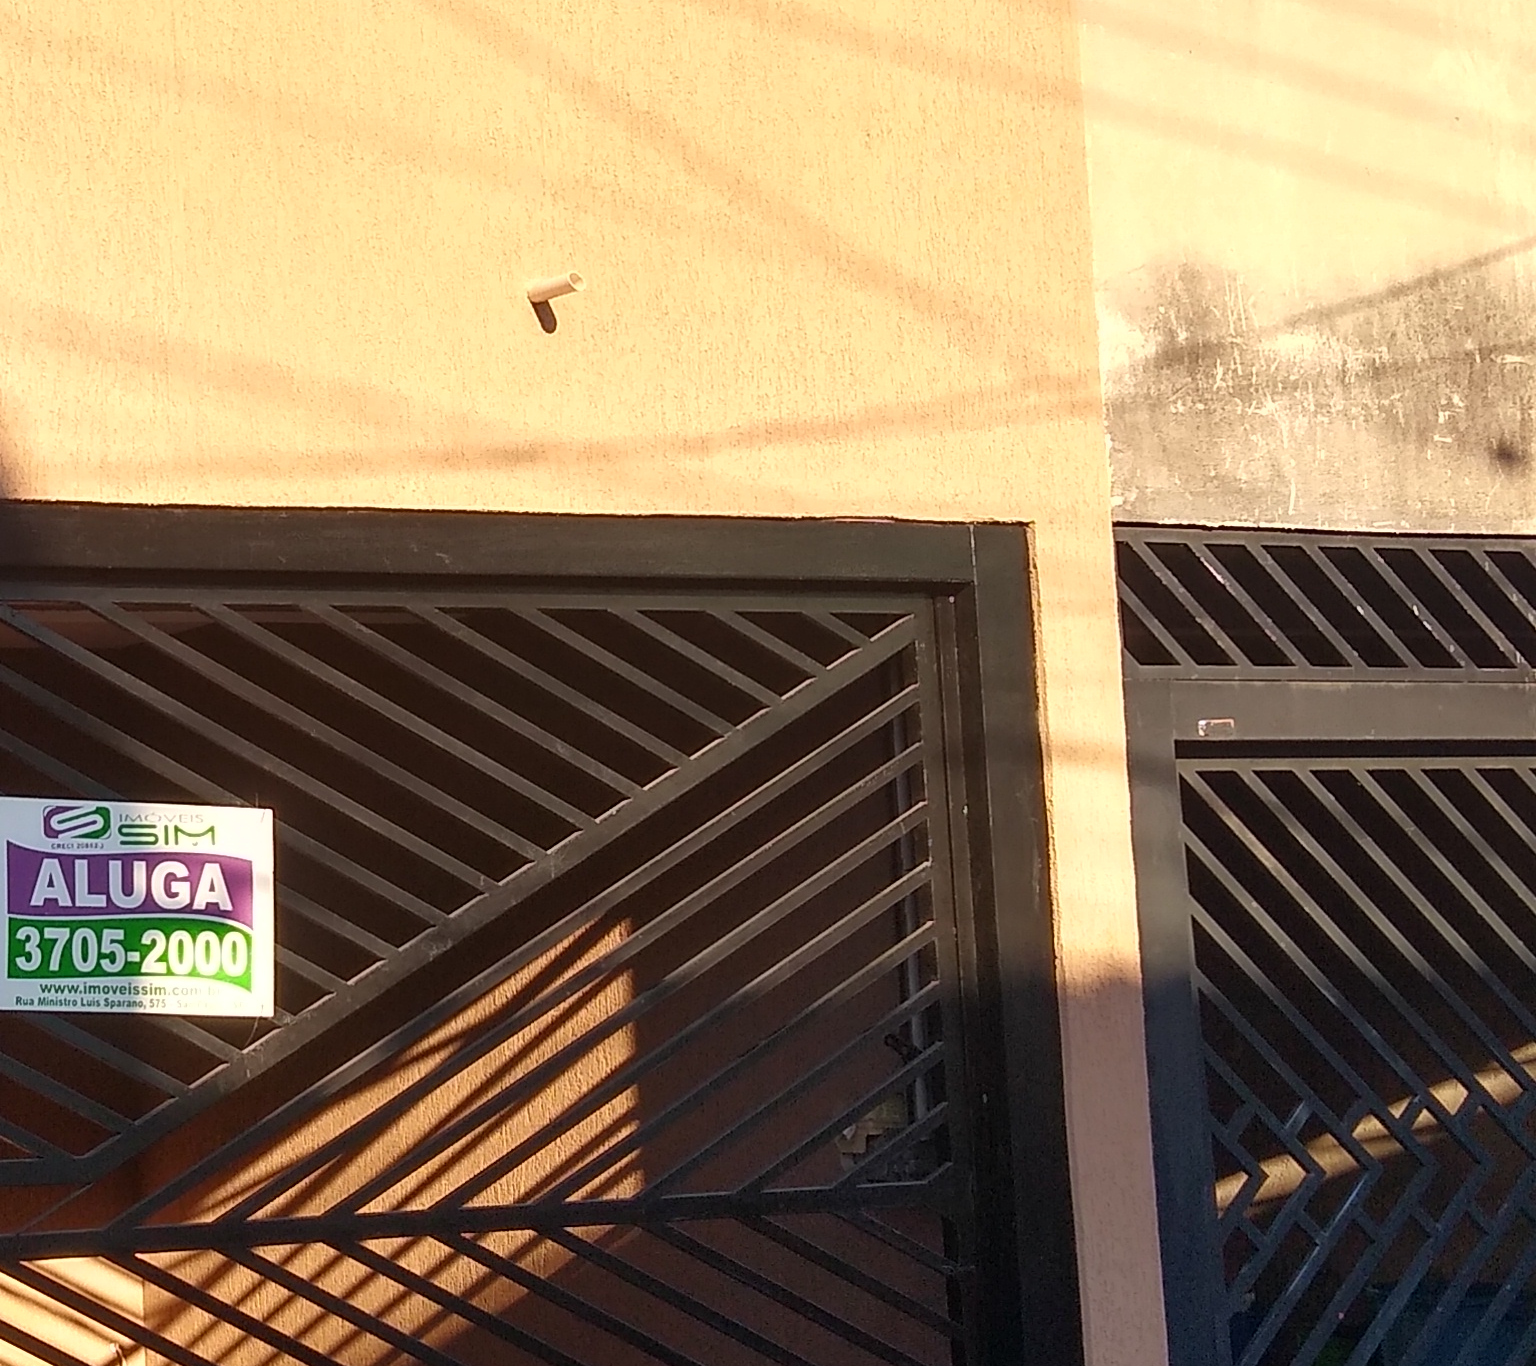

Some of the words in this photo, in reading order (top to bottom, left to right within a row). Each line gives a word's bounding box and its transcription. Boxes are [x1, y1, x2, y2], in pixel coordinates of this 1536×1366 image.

[119, 812, 204, 824] IMÓVEIS
[118, 824, 216, 846] SIM
[29, 857, 234, 911] ALUGA
[15, 925, 249, 977] 3705-2000
[39, 982, 221, 997] www.imoveissim.combr
[15, 996, 35, 1007] Rua
[37, 996, 78, 1008] Ministro
[80, 997, 101, 1008] Luis
[103, 997, 147, 1010] Sparano,
[149, 998, 167, 1009] 575
